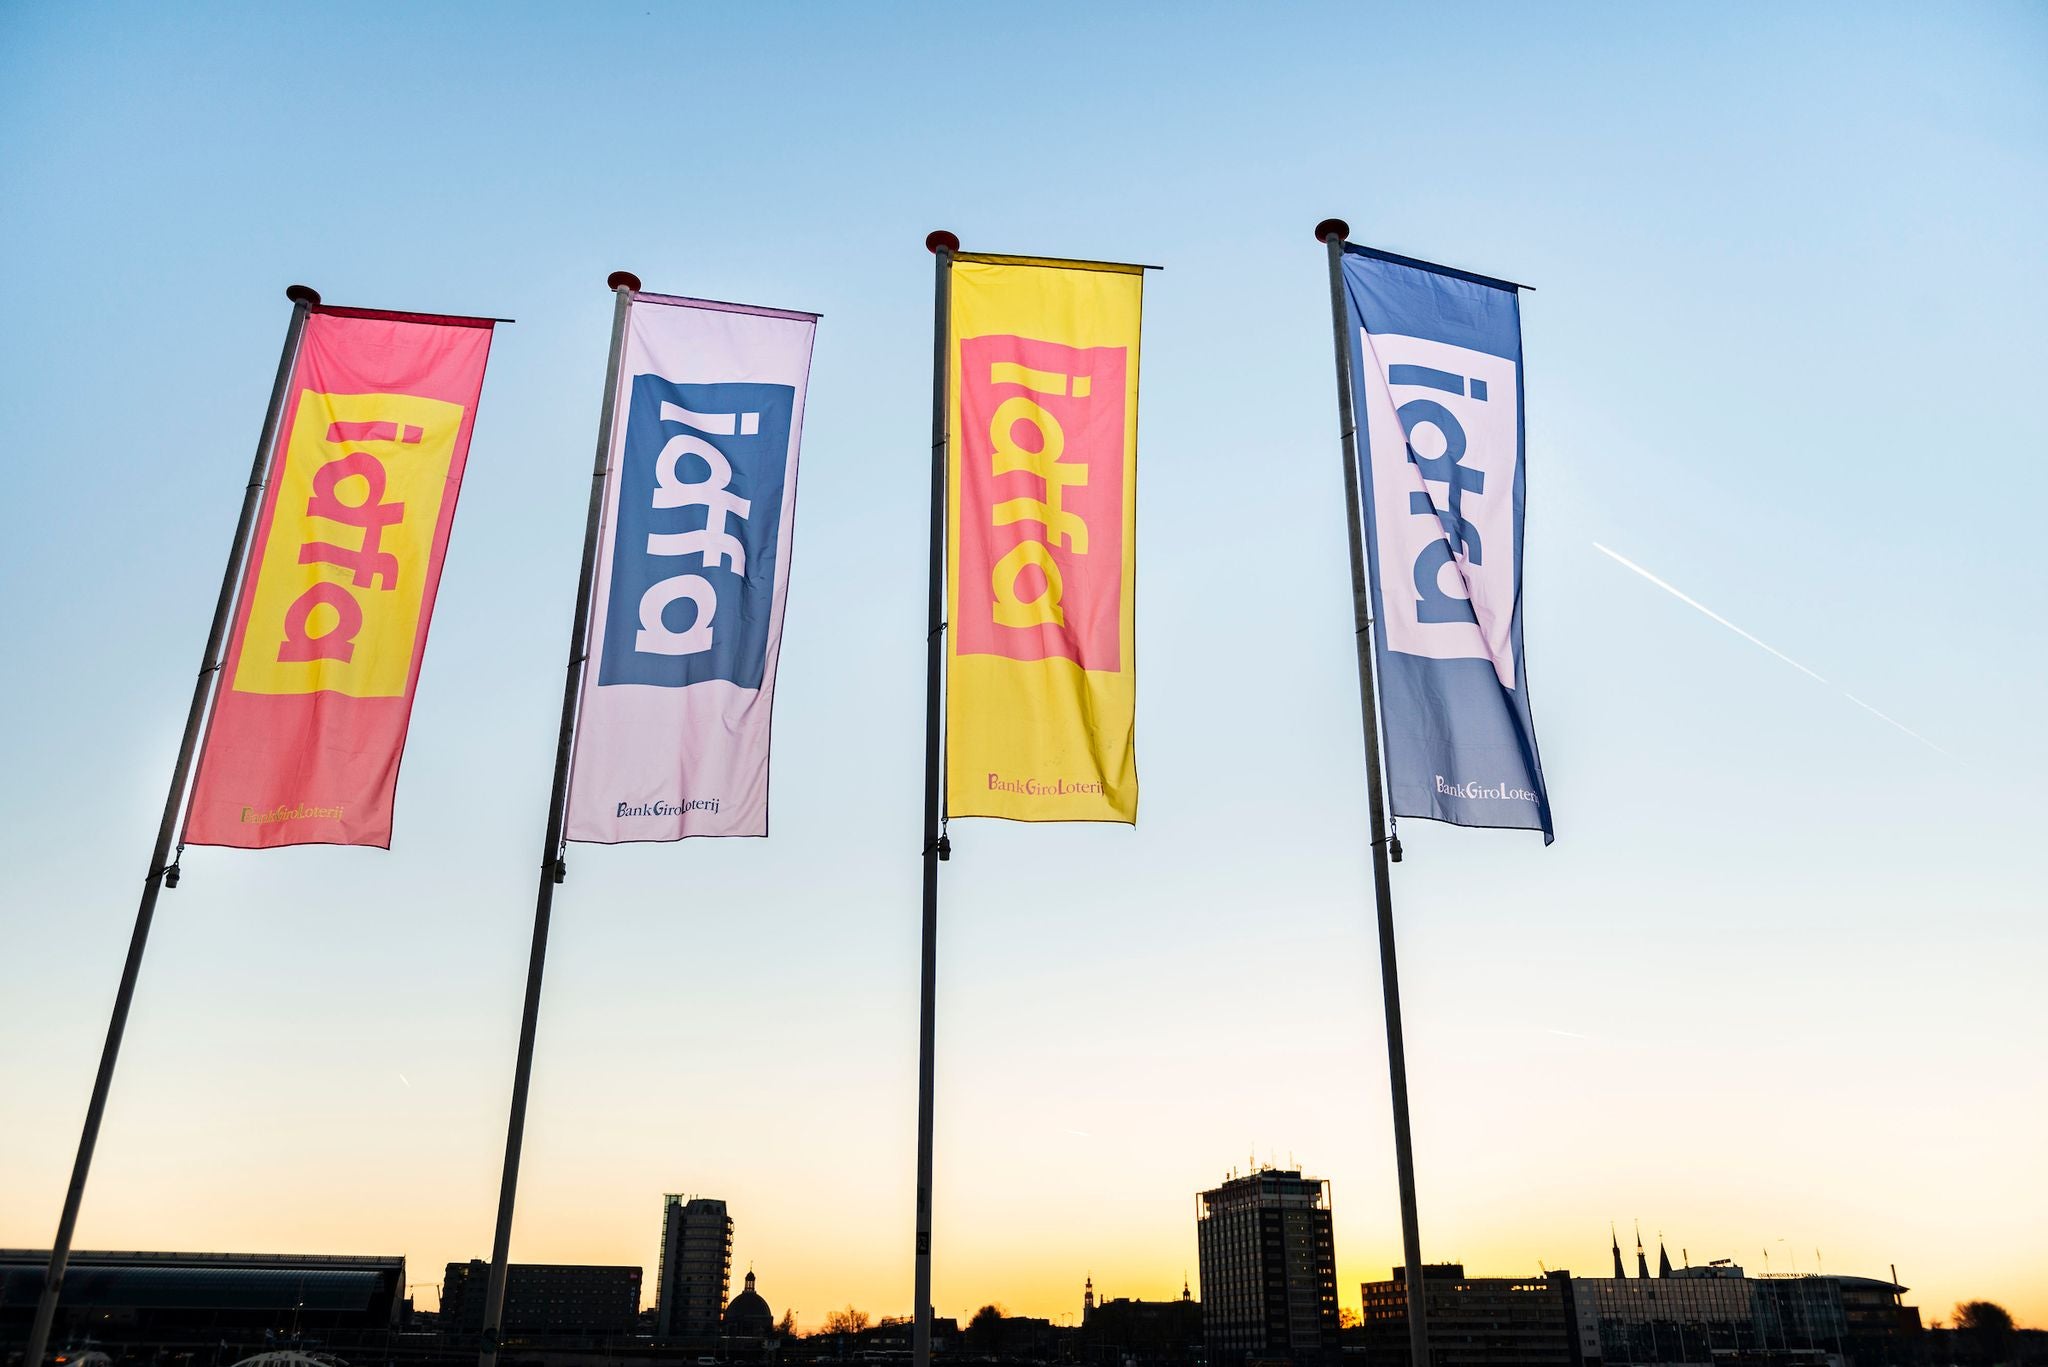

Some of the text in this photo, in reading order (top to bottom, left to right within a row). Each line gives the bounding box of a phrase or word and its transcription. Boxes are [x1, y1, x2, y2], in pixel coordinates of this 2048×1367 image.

[276, 421, 424, 664] idfa
[634, 400, 760, 656] idfa
[990, 361, 1091, 628] idfa
[1388, 364, 1488, 626] idfa
[240, 803, 345, 825] BankGiroLoterij
[616, 798, 720, 818] BankGiroLoterij
[988, 772, 1105, 798] BankGiroLoterij
